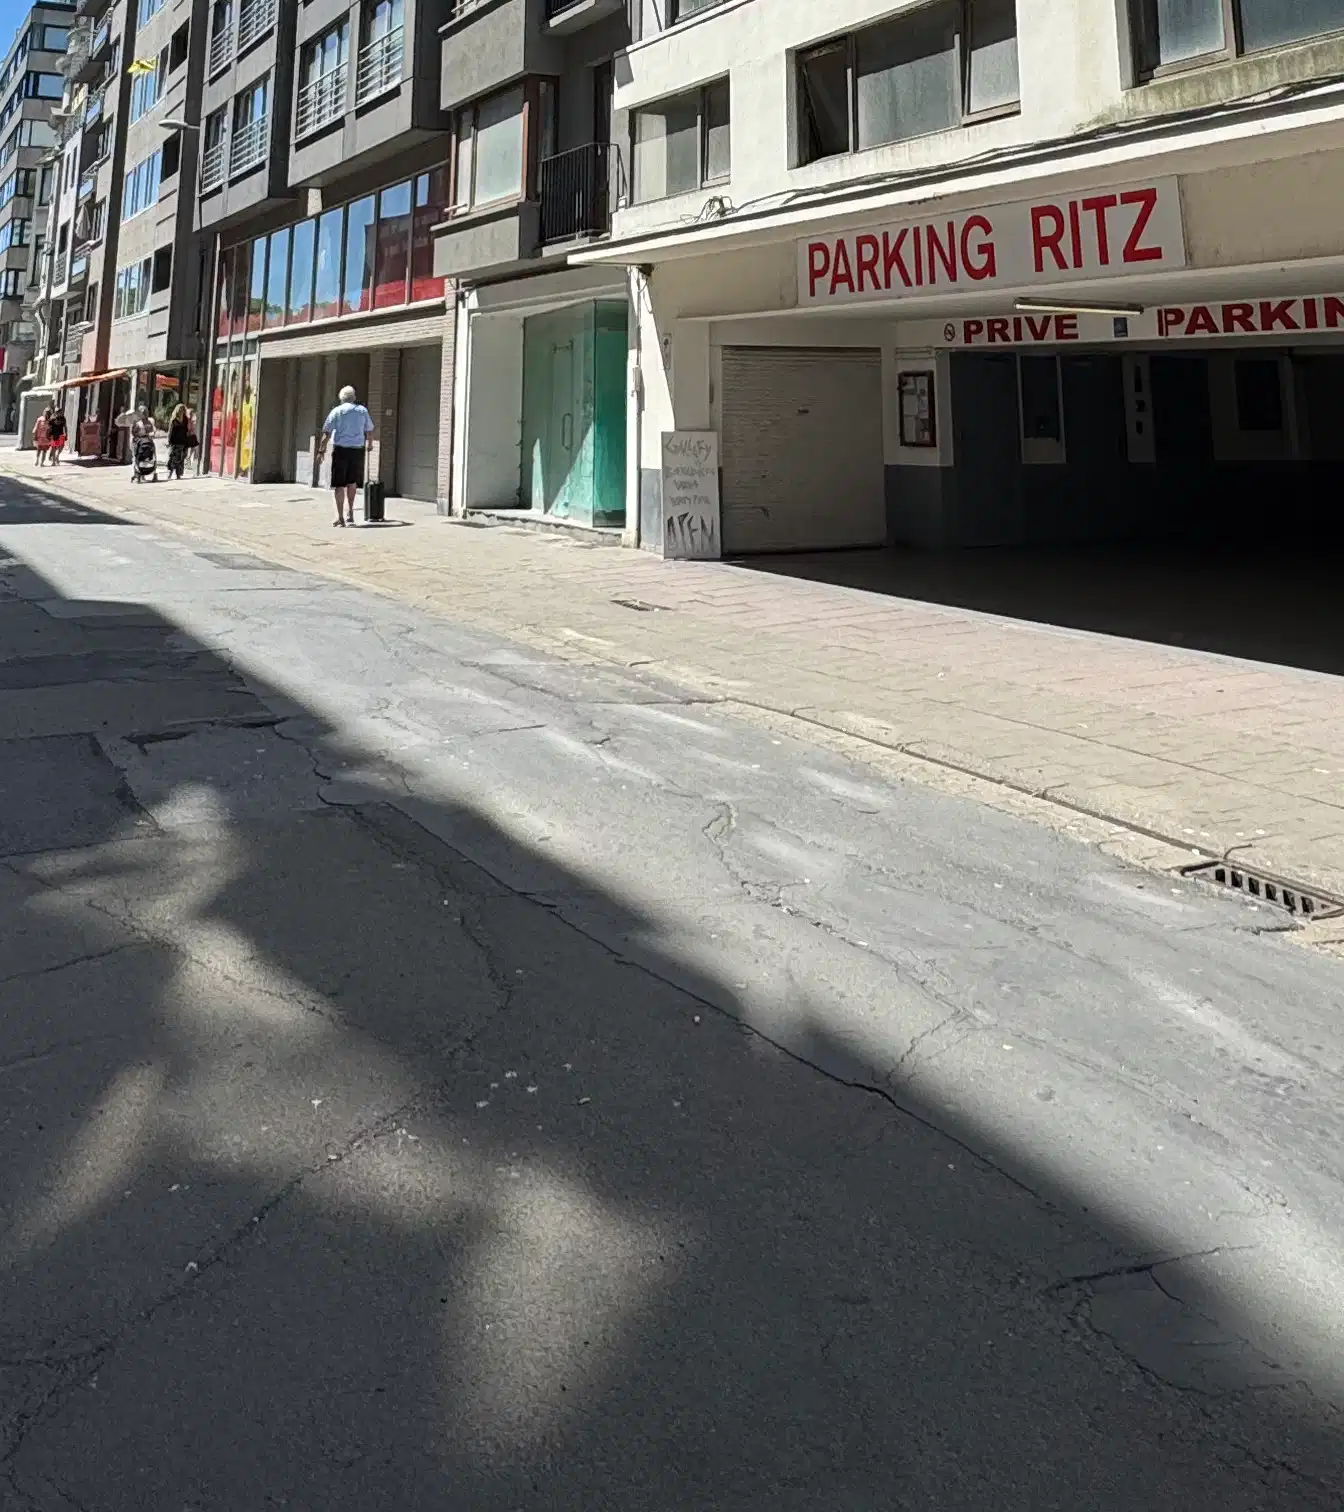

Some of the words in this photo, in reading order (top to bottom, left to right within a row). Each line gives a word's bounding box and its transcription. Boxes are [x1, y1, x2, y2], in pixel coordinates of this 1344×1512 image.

[808, 214, 997, 298] PARKING
[1031, 187, 1163, 273] RITZ
[963, 313, 1079, 344] PRIVE
